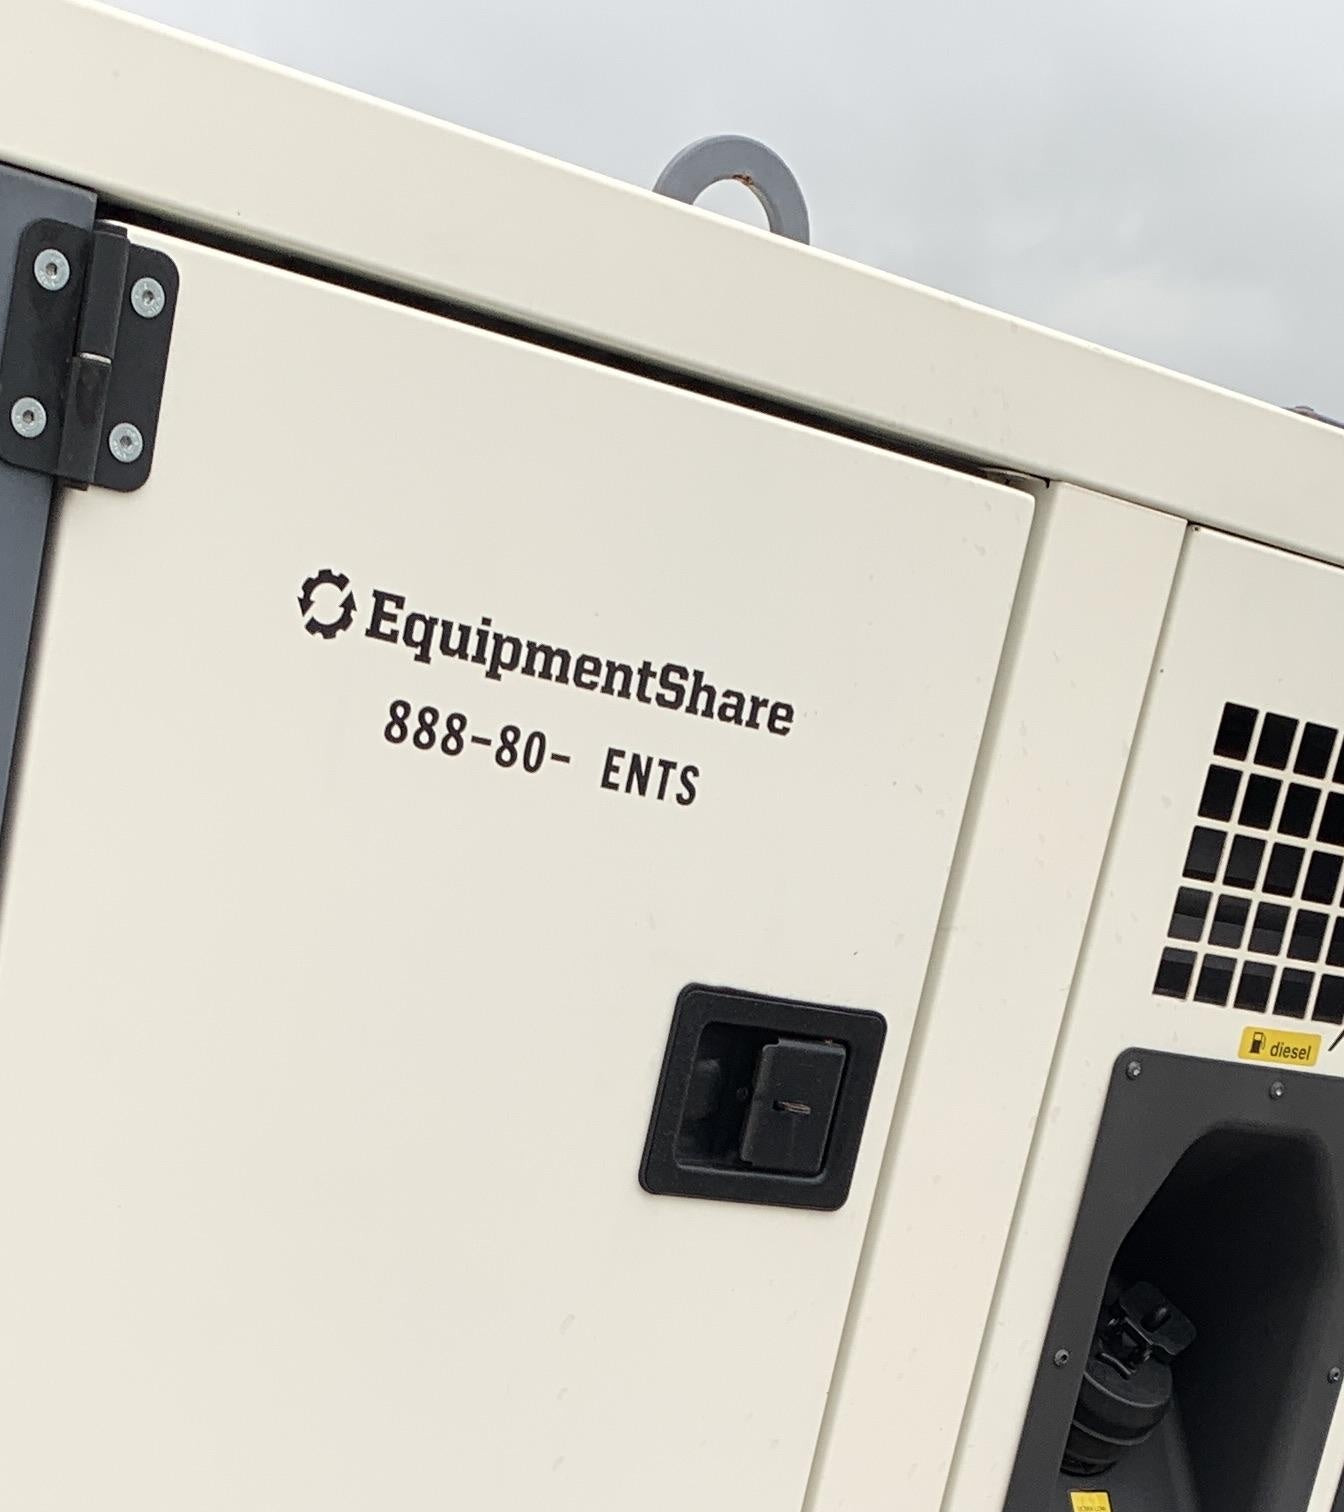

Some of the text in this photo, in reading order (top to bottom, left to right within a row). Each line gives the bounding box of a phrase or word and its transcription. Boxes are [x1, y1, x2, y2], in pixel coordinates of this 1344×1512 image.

[364, 589, 795, 736] EquipmentShare
[383, 698, 700, 806] 888-80- ENTS
[1270, 1041, 1312, 1061] diesel
